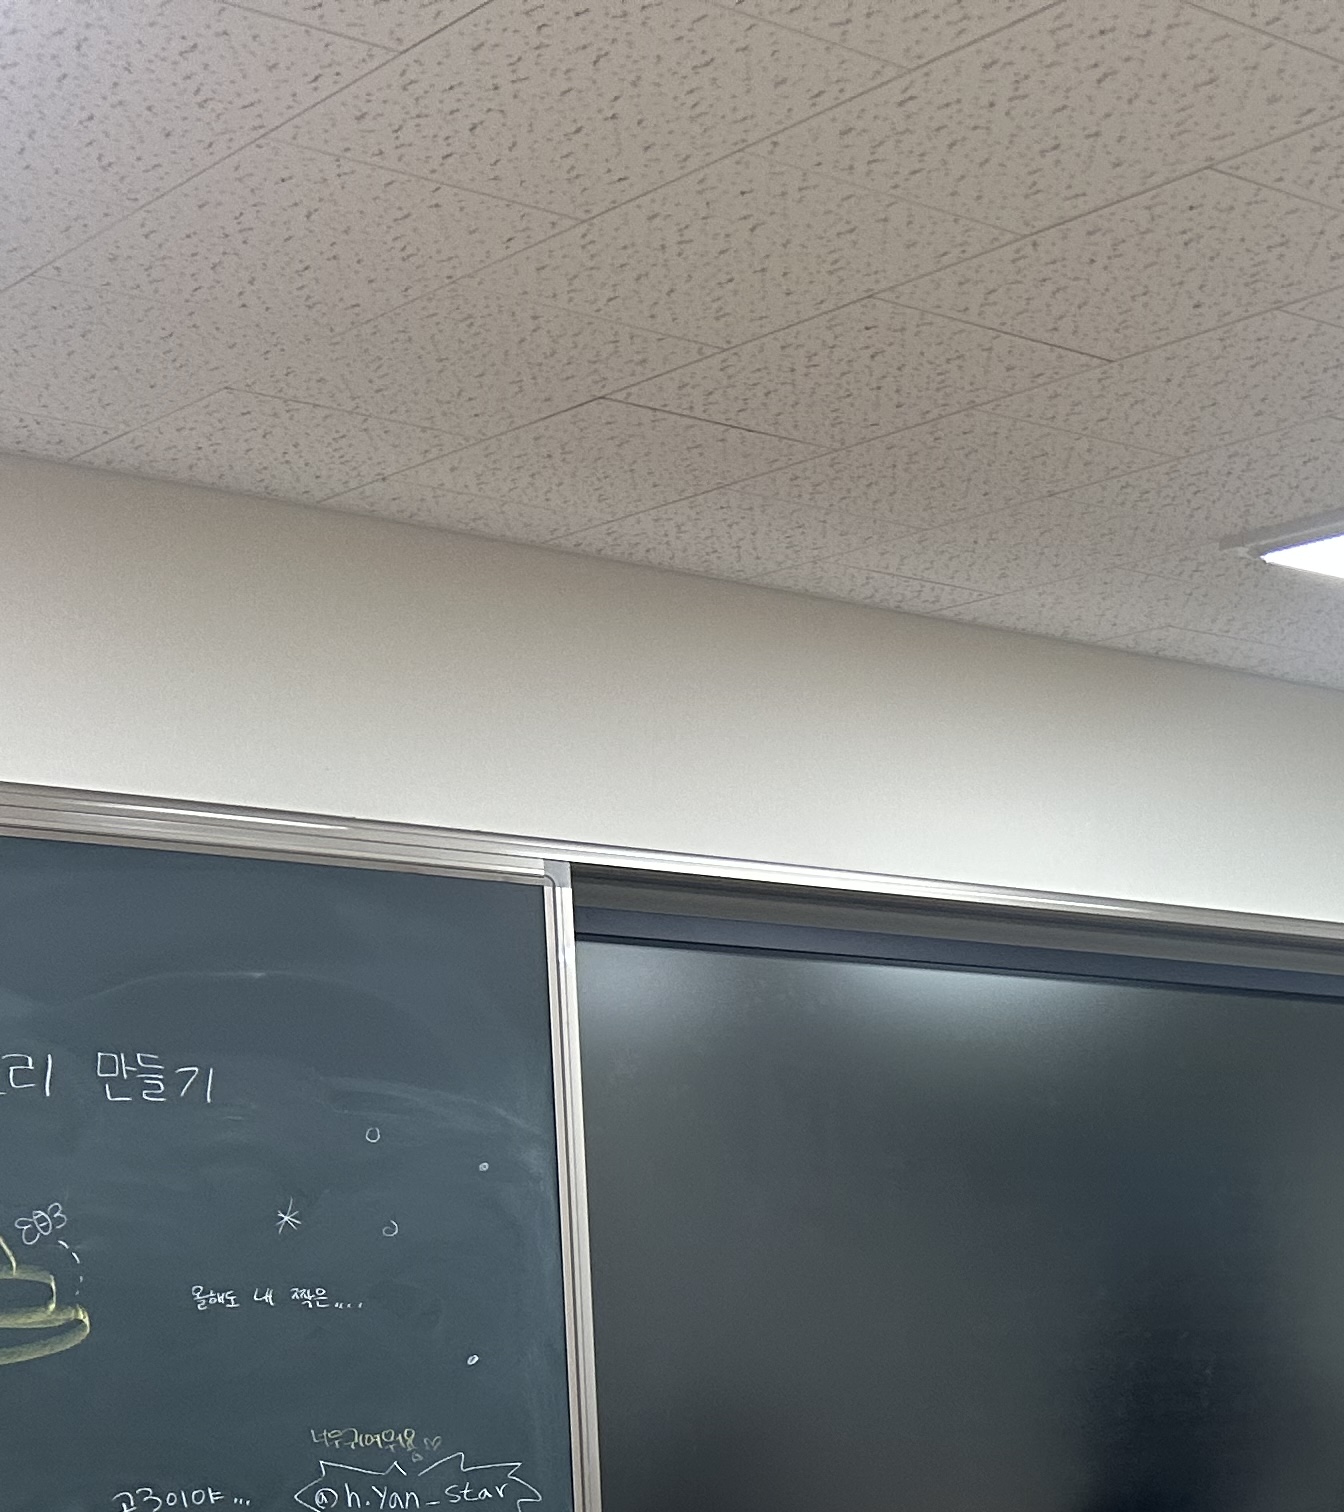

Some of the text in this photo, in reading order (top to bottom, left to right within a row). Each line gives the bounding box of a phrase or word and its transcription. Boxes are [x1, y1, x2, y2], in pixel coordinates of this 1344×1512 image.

[0, 1052, 213, 1103] 리 만들기
[191, 1285, 241, 1311] 올해도
[253, 1287, 275, 1307] 내
